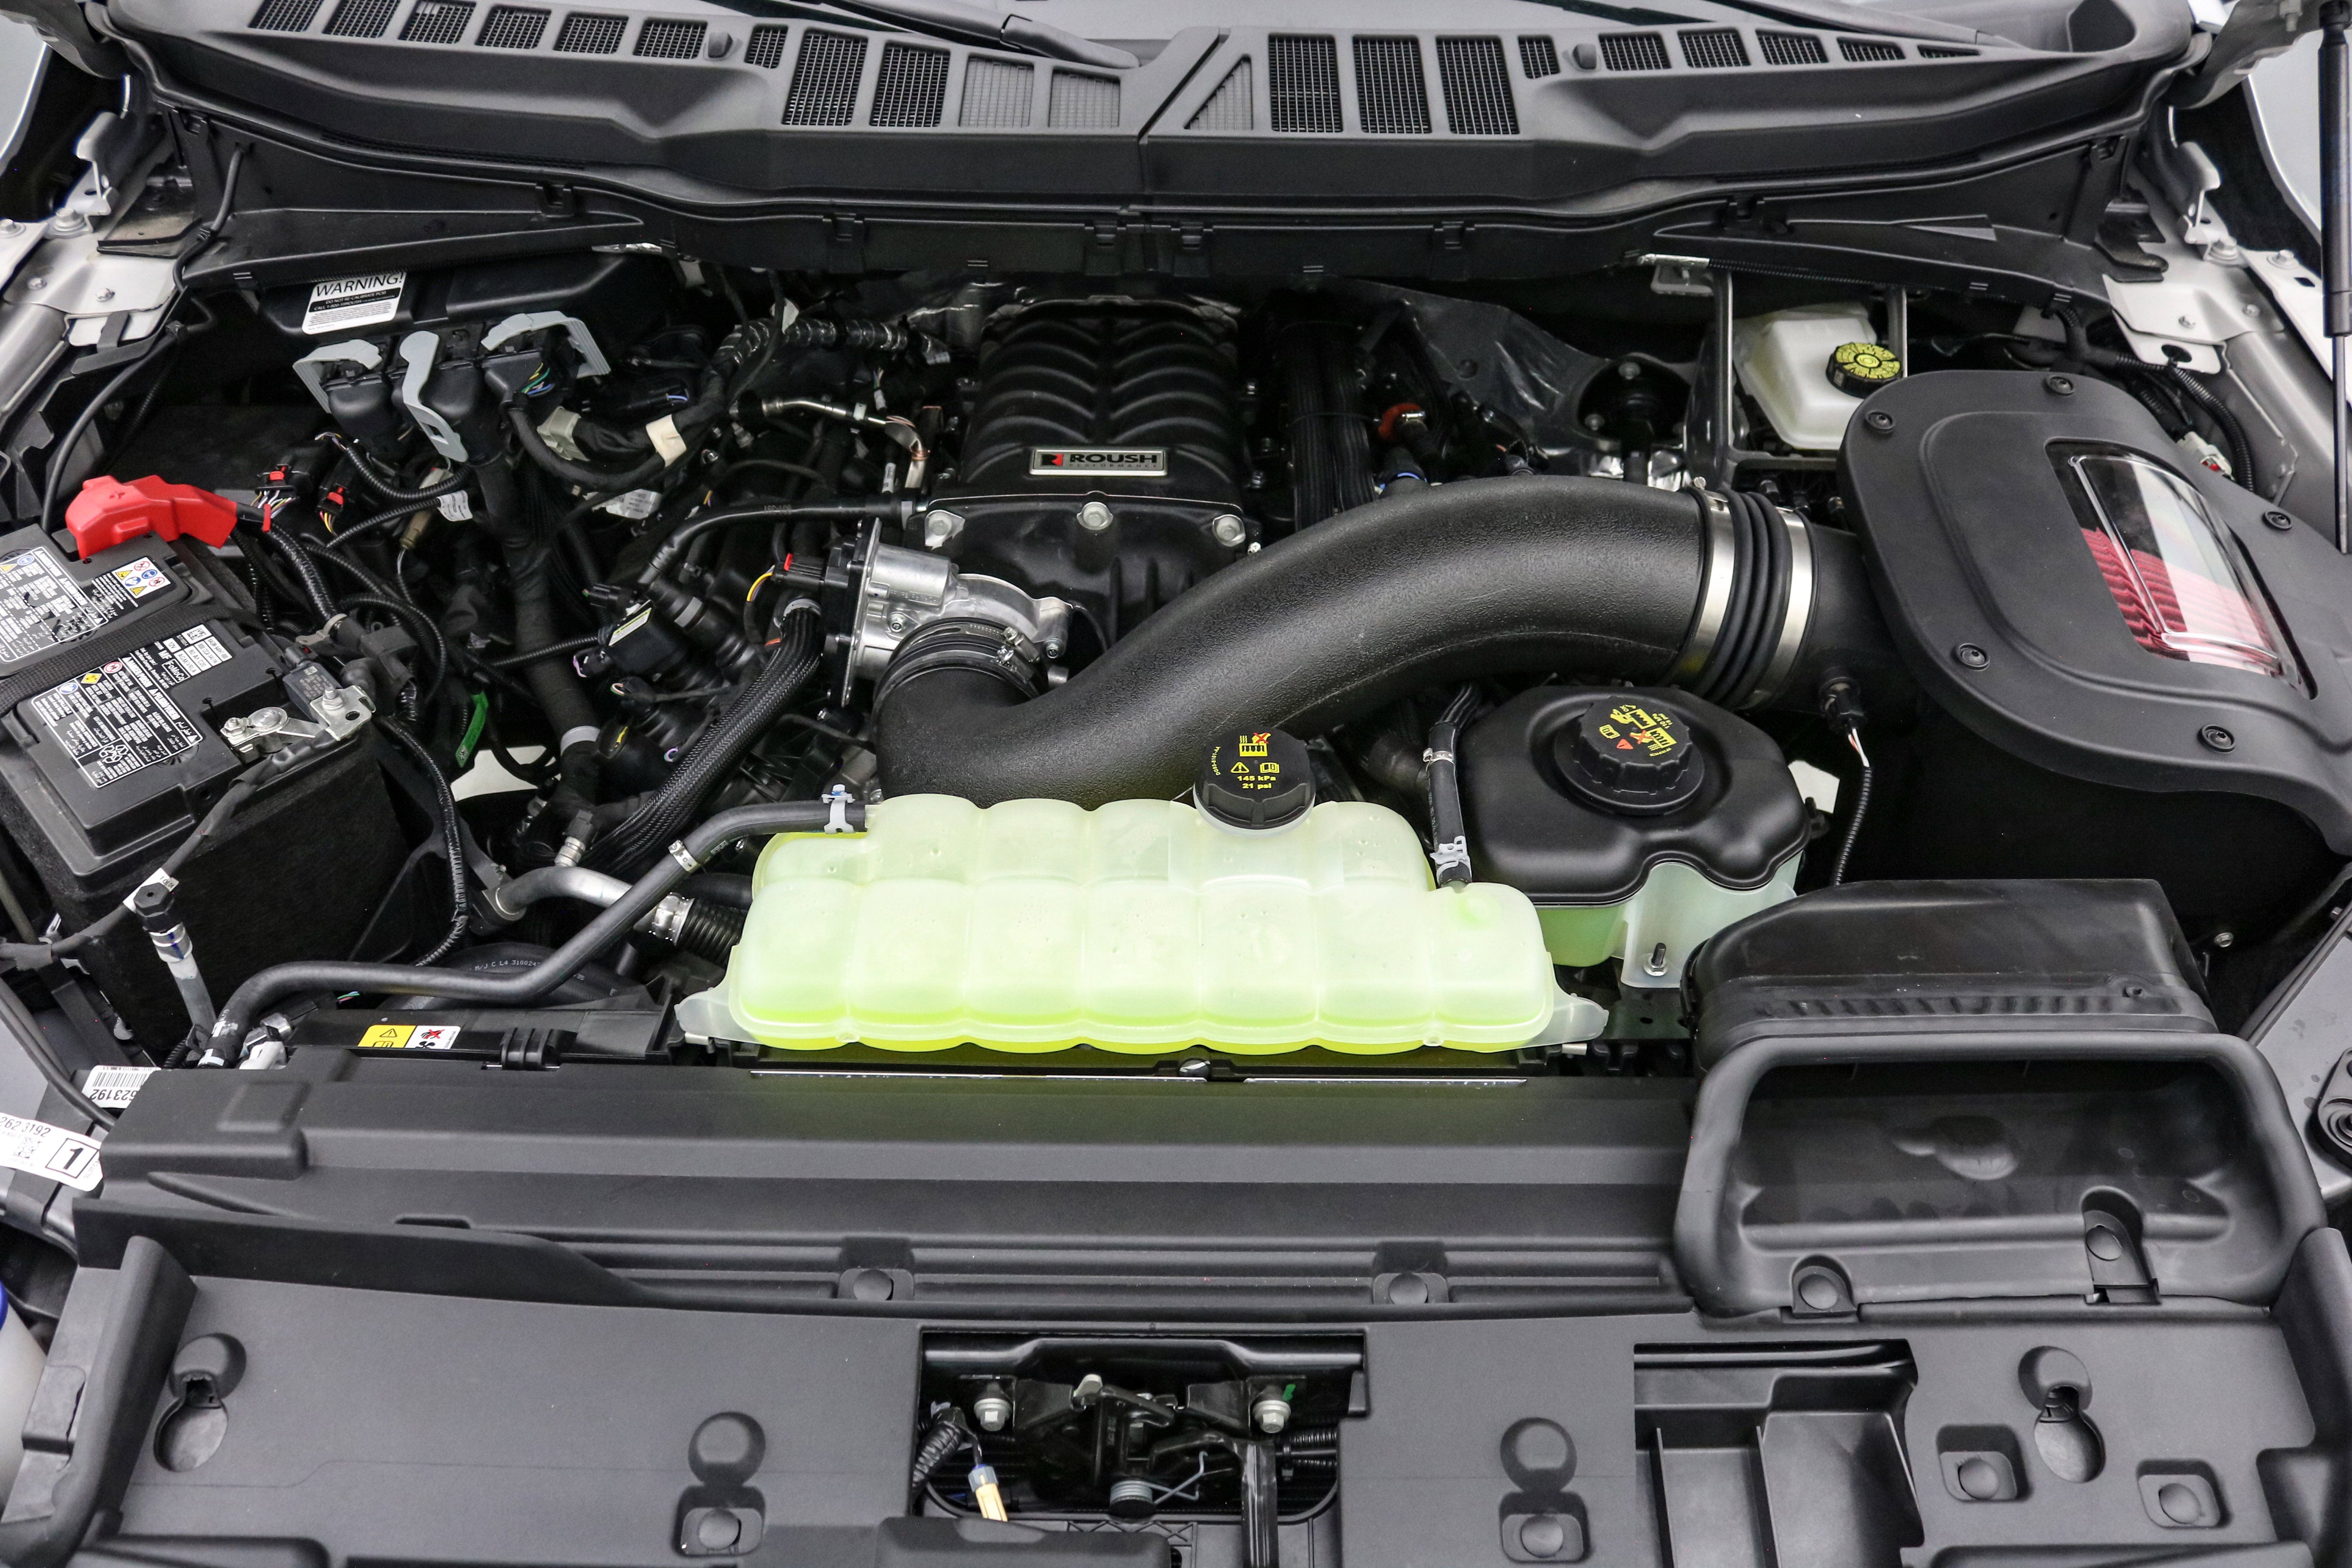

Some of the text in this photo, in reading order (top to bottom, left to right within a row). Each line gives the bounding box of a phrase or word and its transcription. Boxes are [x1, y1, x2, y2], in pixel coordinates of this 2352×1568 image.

[316, 272, 403, 297] WARNING!
[1070, 454, 1157, 463] ROUSH
[158, 650, 172, 661] MF
[176, 653, 198, 673] AGM/VRLA
[197, 659, 207, 667] C20
[165, 661, 187, 681] FoMoCo
[89, 1089, 140, 1101] 623192
[22, 1122, 51, 1138] 3192
[62, 1147, 85, 1170] 1
